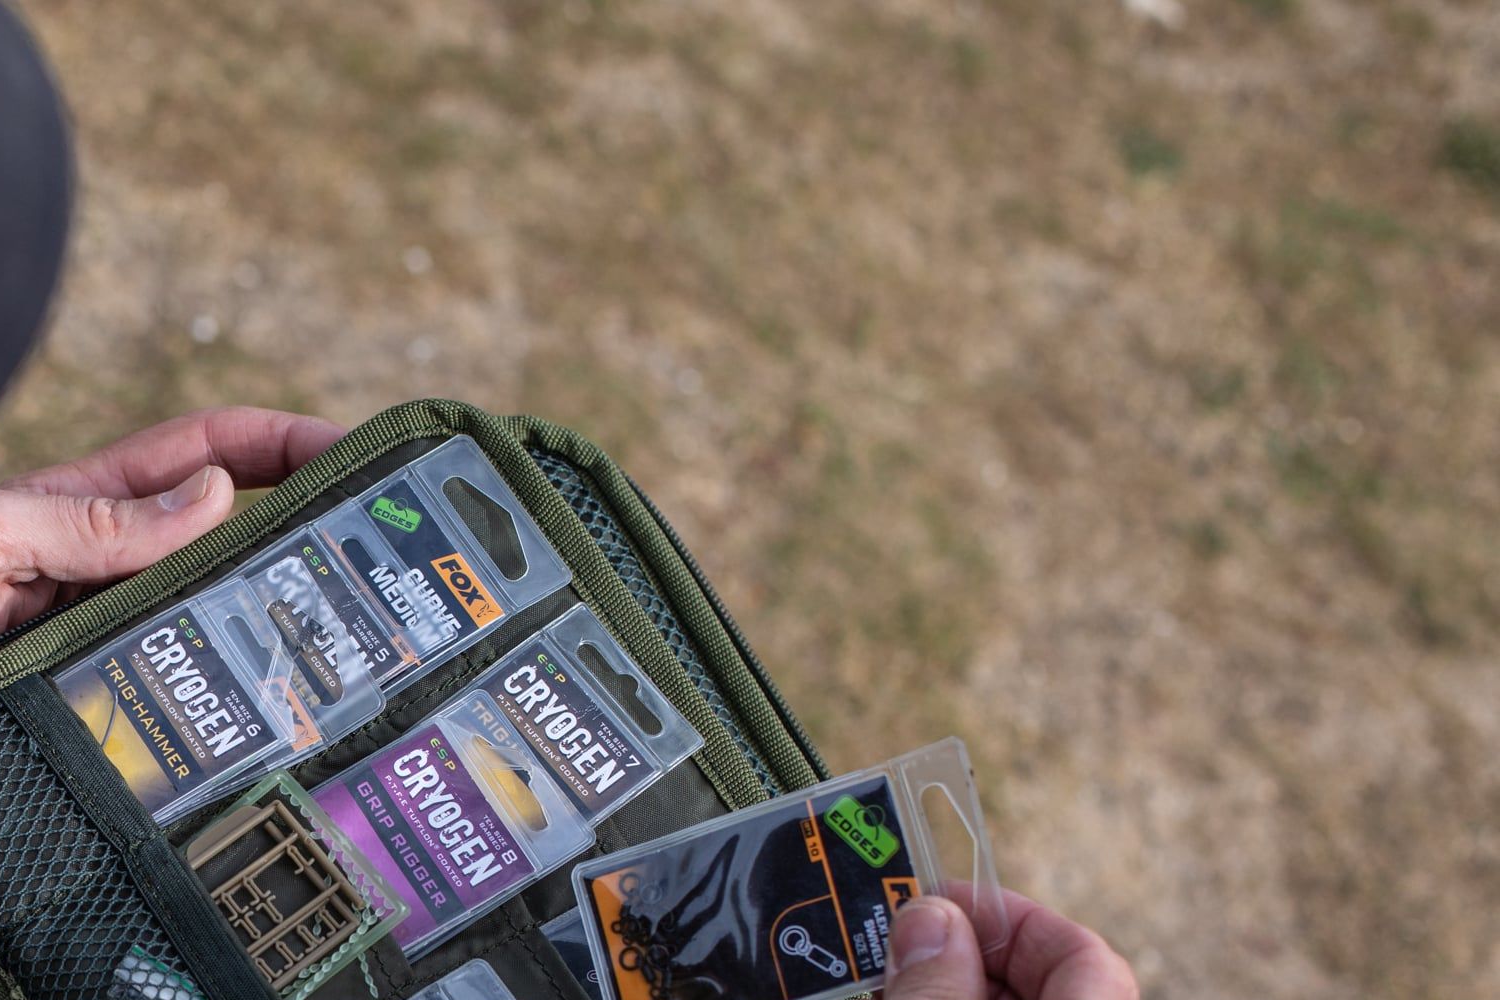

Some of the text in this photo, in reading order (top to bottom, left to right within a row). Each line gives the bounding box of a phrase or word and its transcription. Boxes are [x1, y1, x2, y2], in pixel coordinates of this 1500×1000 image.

[373, 508, 414, 529] EDGES
[404, 568, 462, 640] CURVE
[438, 559, 487, 606] FOX
[352, 624, 373, 650] BARBED
[367, 629, 380, 646] SIZE
[375, 648, 390, 662] 5
[141, 626, 246, 757] CRYOGEN
[310, 655, 336, 687] COATED
[105, 658, 190, 779] TRIG-HAMMER
[225, 697, 246, 724] BARBED
[229, 689, 261, 737] TEN SIZE 6
[504, 664, 626, 794] CRYOGEN
[181, 726, 205, 759] COATED
[597, 730, 622, 758] BARBED
[600, 722, 641, 769] TEN SIZE 7
[559, 764, 589, 797] COATED
[393, 748, 503, 887] CRYOGEN
[478, 822, 501, 851] BARBED
[483, 814, 518, 866] TEN SIZE 8
[829, 810, 884, 860] EDGES
[356, 781, 447, 908] GRIP RIGGER
[436, 853, 463, 887] COATED
[853, 933, 873, 971] SIZE 11
[864, 919, 885, 969] SWIVELS
